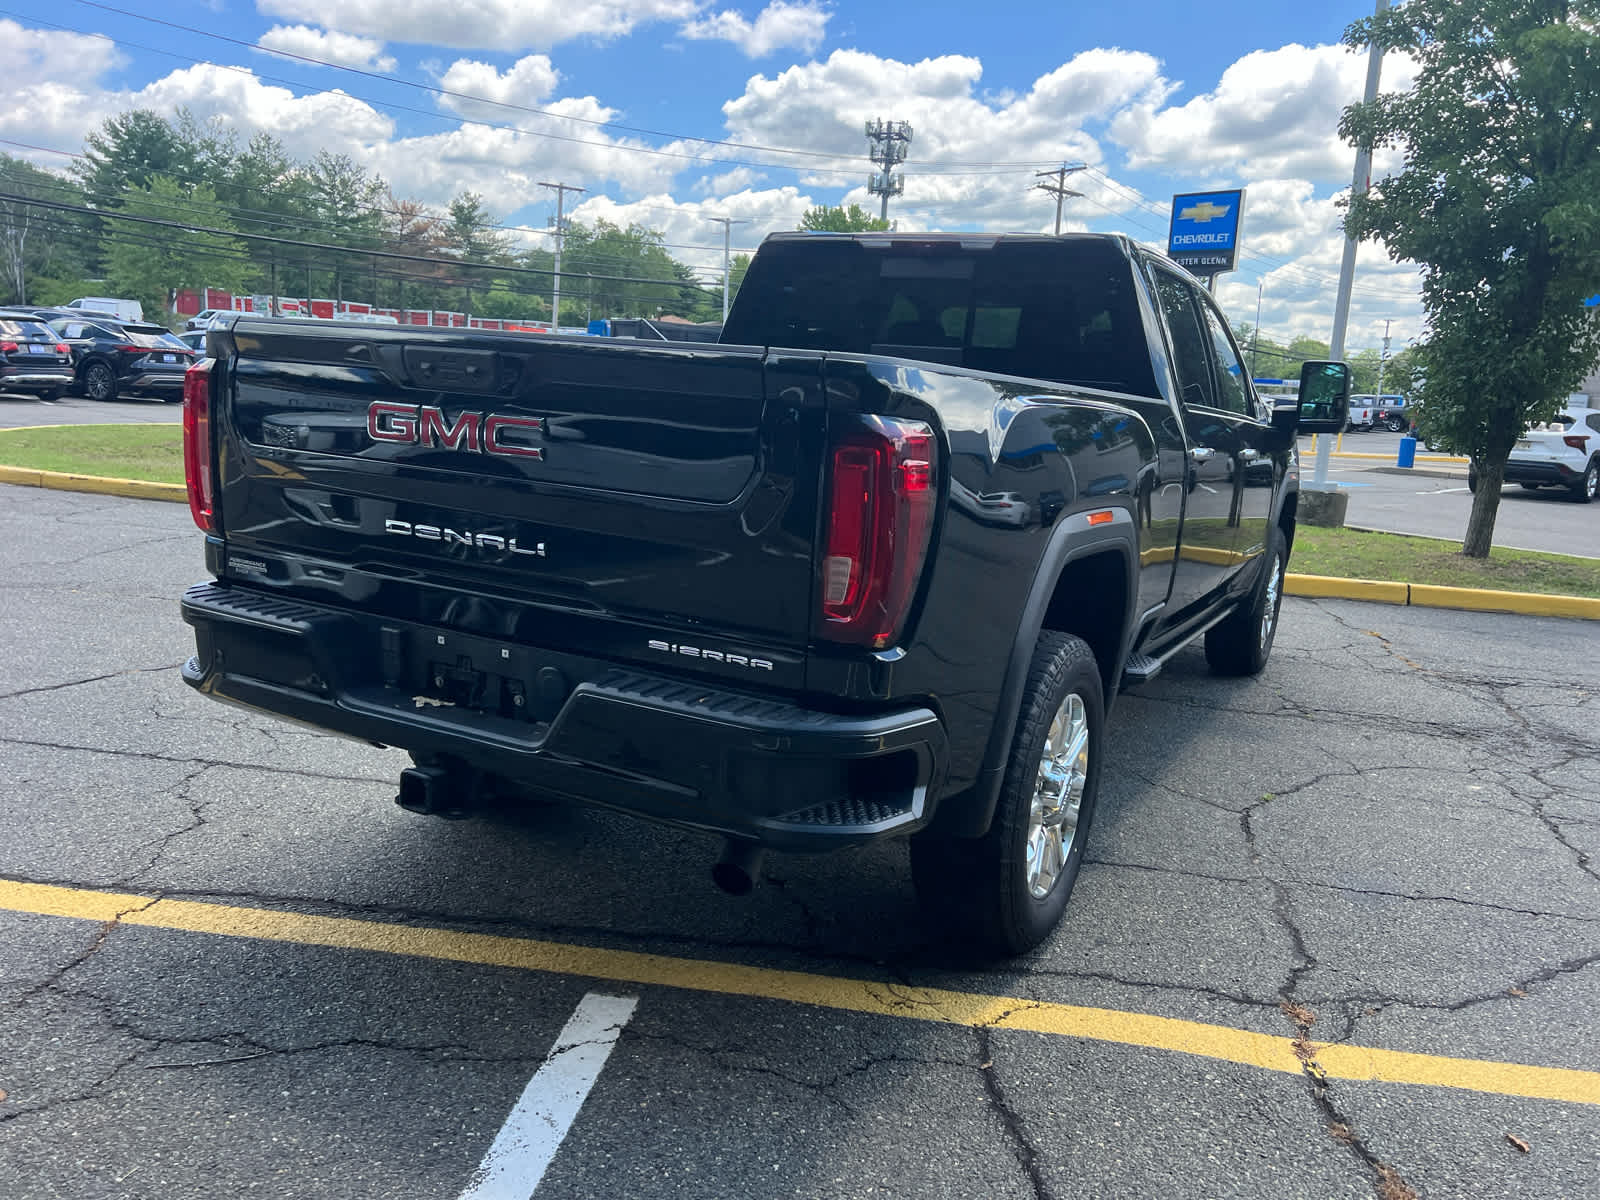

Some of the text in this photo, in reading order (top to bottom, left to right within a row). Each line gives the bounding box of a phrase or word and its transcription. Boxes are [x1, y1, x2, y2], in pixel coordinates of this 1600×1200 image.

[1173, 233, 1230, 244] CHEVROLET
[1176, 257, 1198, 265] ESTER
[367, 400, 545, 461] GMC
[385, 518, 546, 557] DENALI
[648, 640, 773, 670] SIERRA
